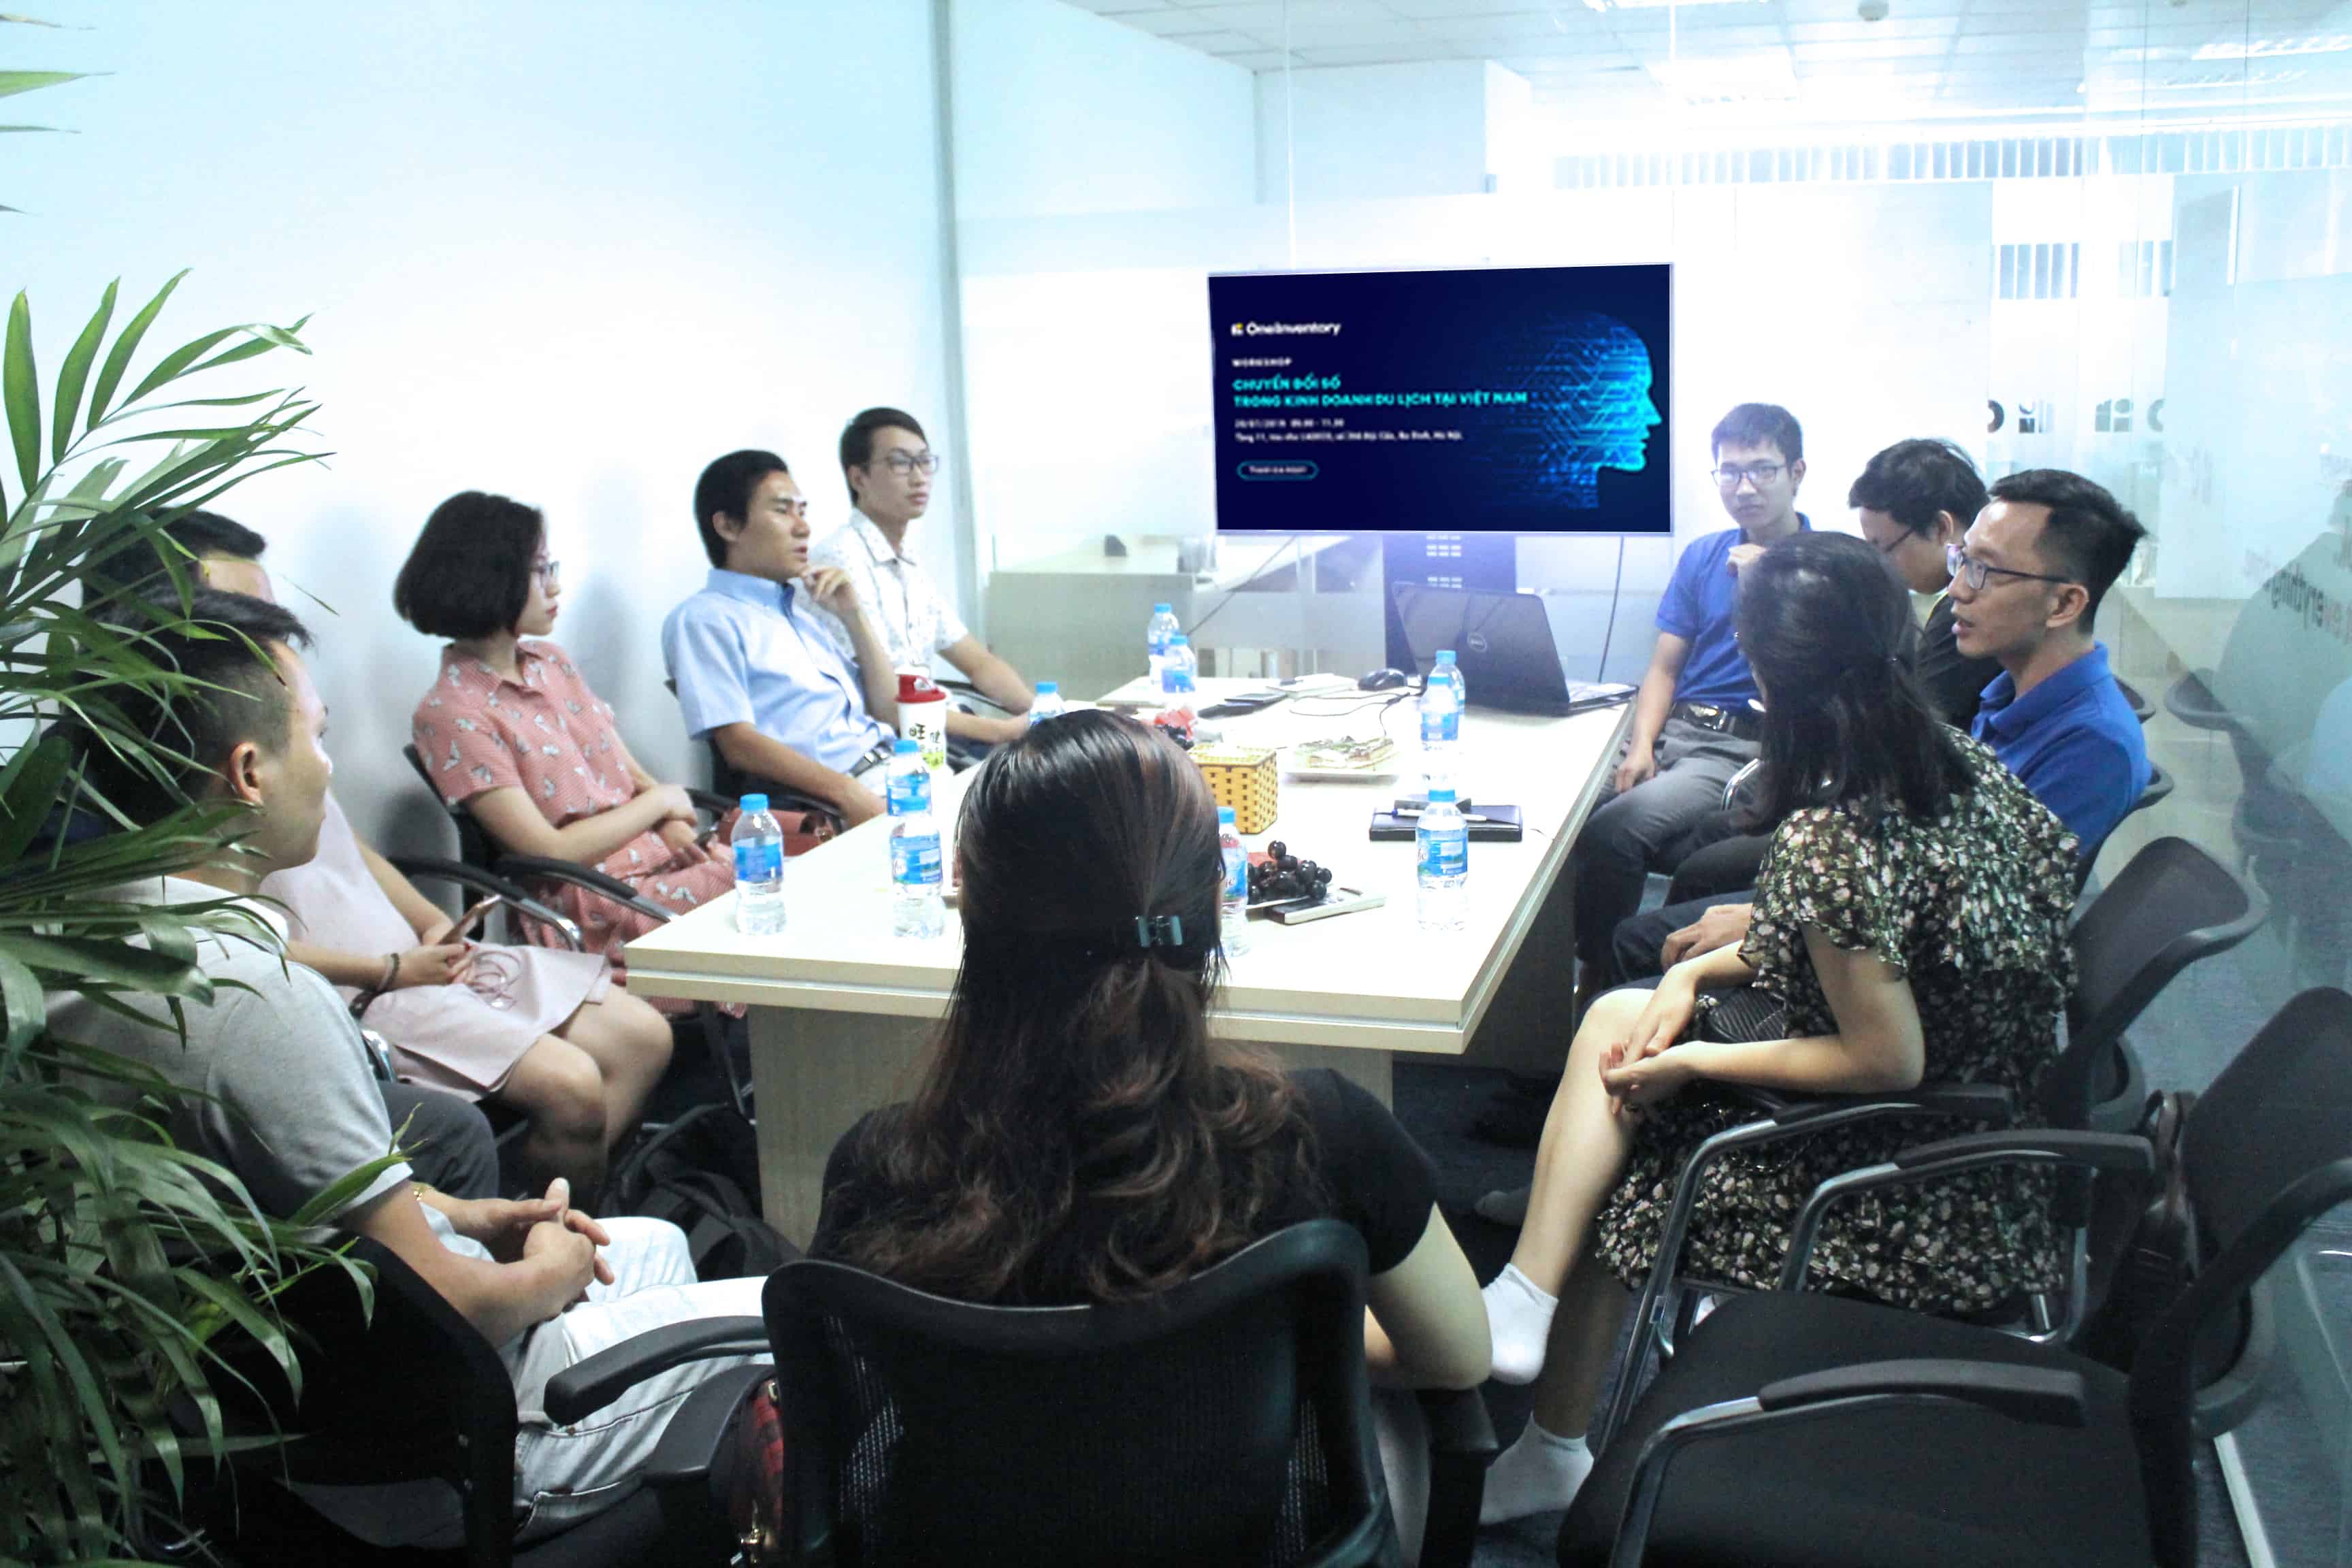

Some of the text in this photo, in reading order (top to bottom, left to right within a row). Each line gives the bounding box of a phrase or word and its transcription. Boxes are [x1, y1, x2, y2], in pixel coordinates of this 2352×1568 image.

[1232, 357, 1292, 368] WORKSHOP
[1235, 395, 1280, 407] TRONG
[1285, 395, 1318, 406] KINH
[1322, 393, 1372, 406] DOANH
[1375, 393, 1394, 405] DU
[1397, 393, 1430, 408] LỊCH
[1434, 392, 1456, 407] TẠI
[1493, 392, 1527, 403] NAM
